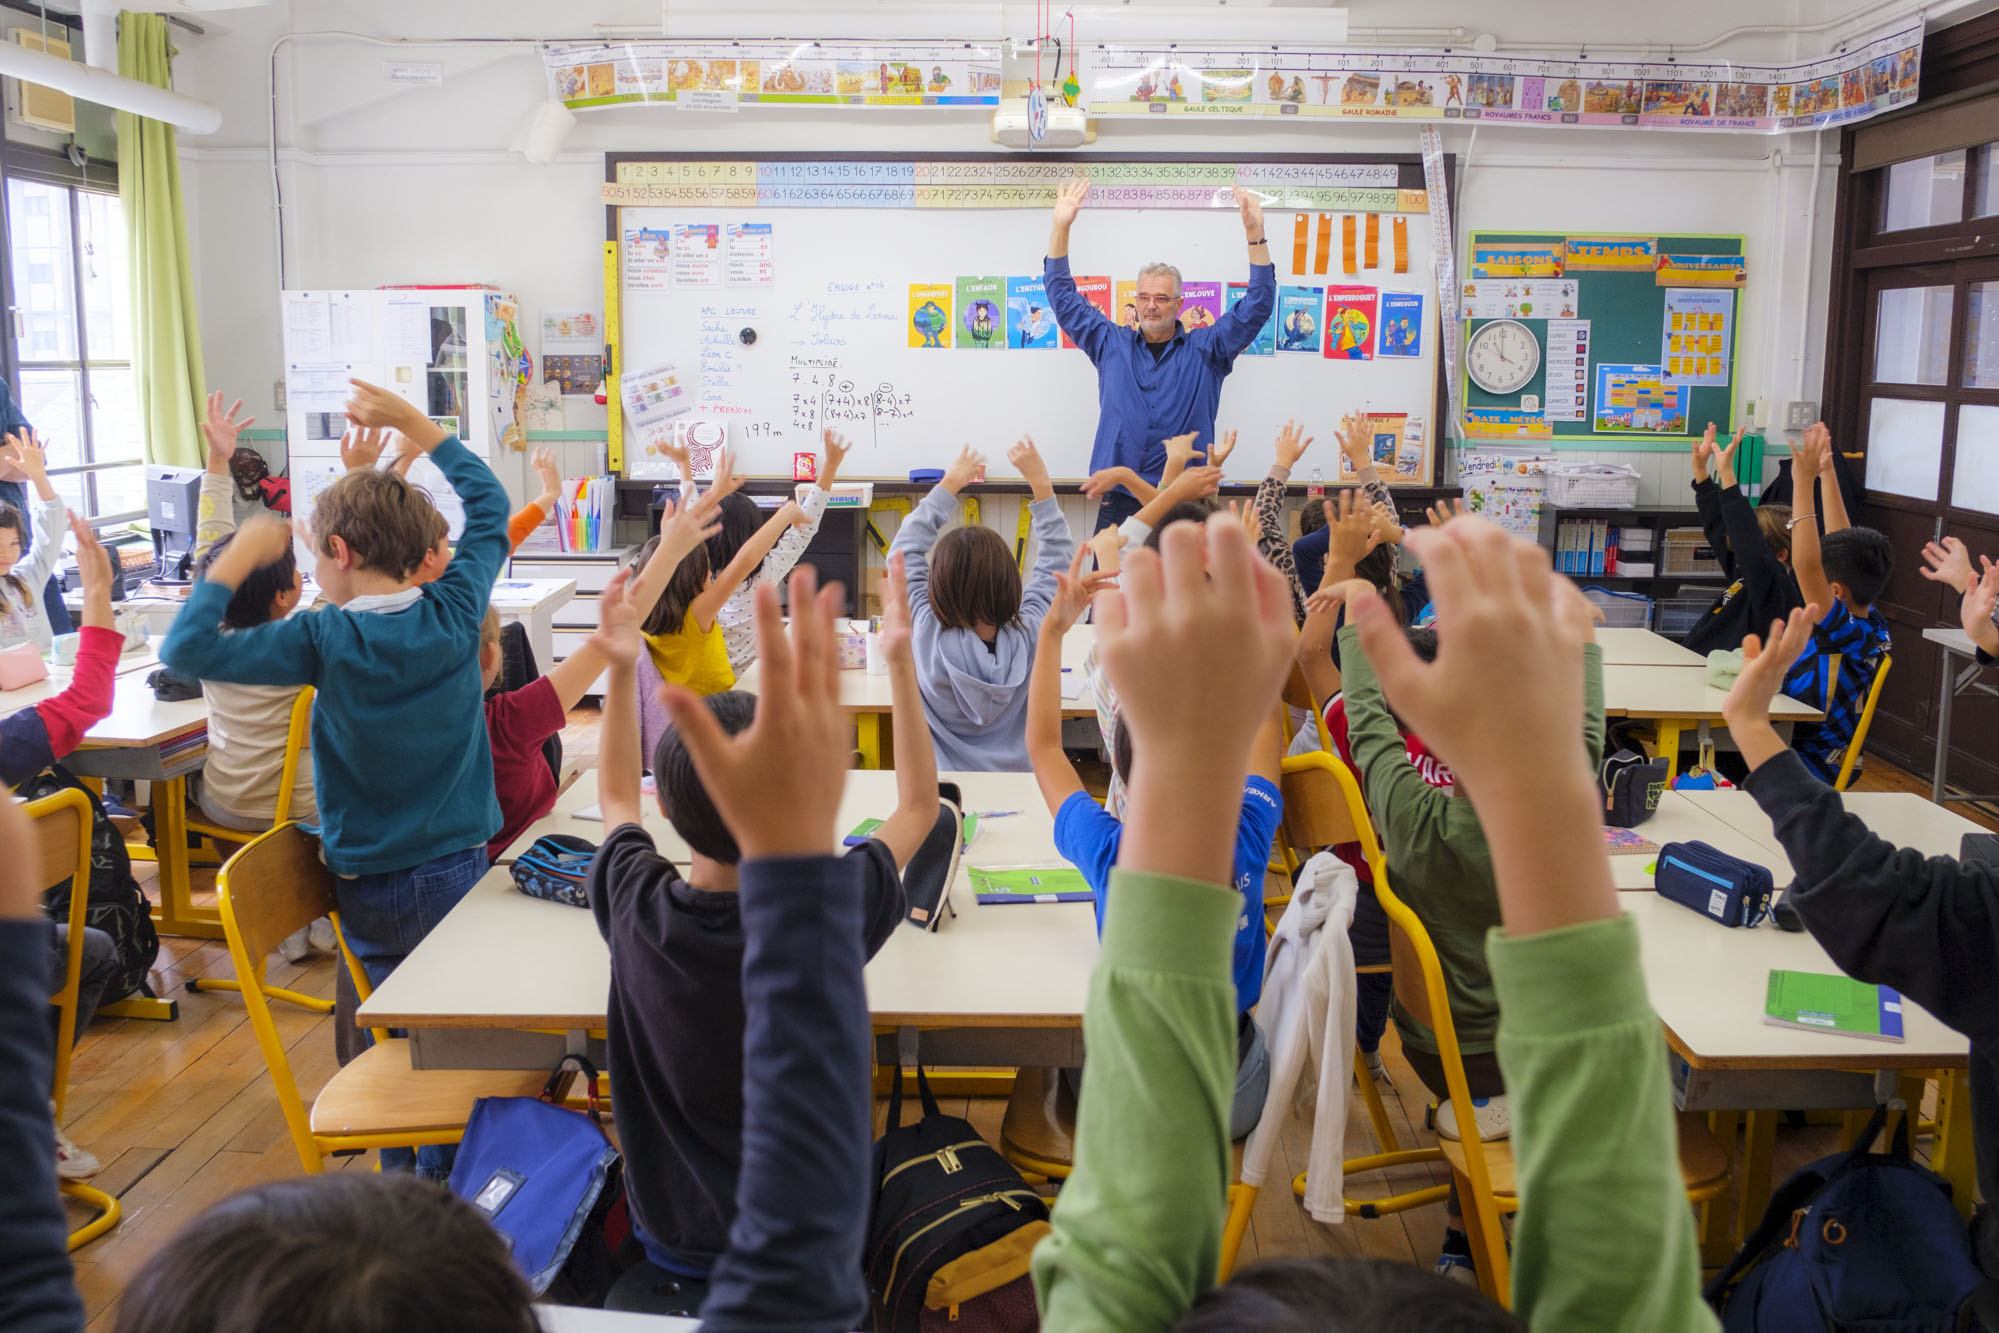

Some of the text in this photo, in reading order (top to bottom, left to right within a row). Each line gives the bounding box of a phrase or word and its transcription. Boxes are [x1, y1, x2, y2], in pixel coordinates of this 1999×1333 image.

[1666, 69, 1683, 77] 1101
[1700, 70, 1718, 78] 1201
[1735, 71, 1752, 79] 1301
[1803, 69, 1819, 77] 1501
[1184, 105, 1243, 113] GAULE CELTIQUE
[1365, 109, 1398, 117] ROMAINE
[1485, 111, 1552, 121] ROYAUMES FRANCS
[1680, 118, 1714, 126] ROYAUME
[1729, 119, 1756, 127] FRANCE
[622, 166, 1397, 179] 1 2 3 4 5 6 7 8 9 10 11 12 13 14 15 16 17 18 19 20 21 22 23 24 25 26 27 28 29 30 31 32 33 34 35 36 37 38 39 40 41 42 43 44 45 46 47 48 49
[601, 188, 1425, 202] 50 60 70 81 82 83 84 85 86 87 95 96 97 98 99 100
[1576, 246, 1646, 258] TEMPS
[1486, 255, 1552, 266] SAISONS
[1664, 262, 1742, 270] ANNIVERSAIRES
[966, 284, 998, 293] L'ENFAON
[1015, 285, 1045, 294] L'ENCYGN
[1076, 283, 1108, 293] NGOUROU
[1328, 293, 1376, 302] L'ENPERROQUET
[701, 307, 717, 316] APC
